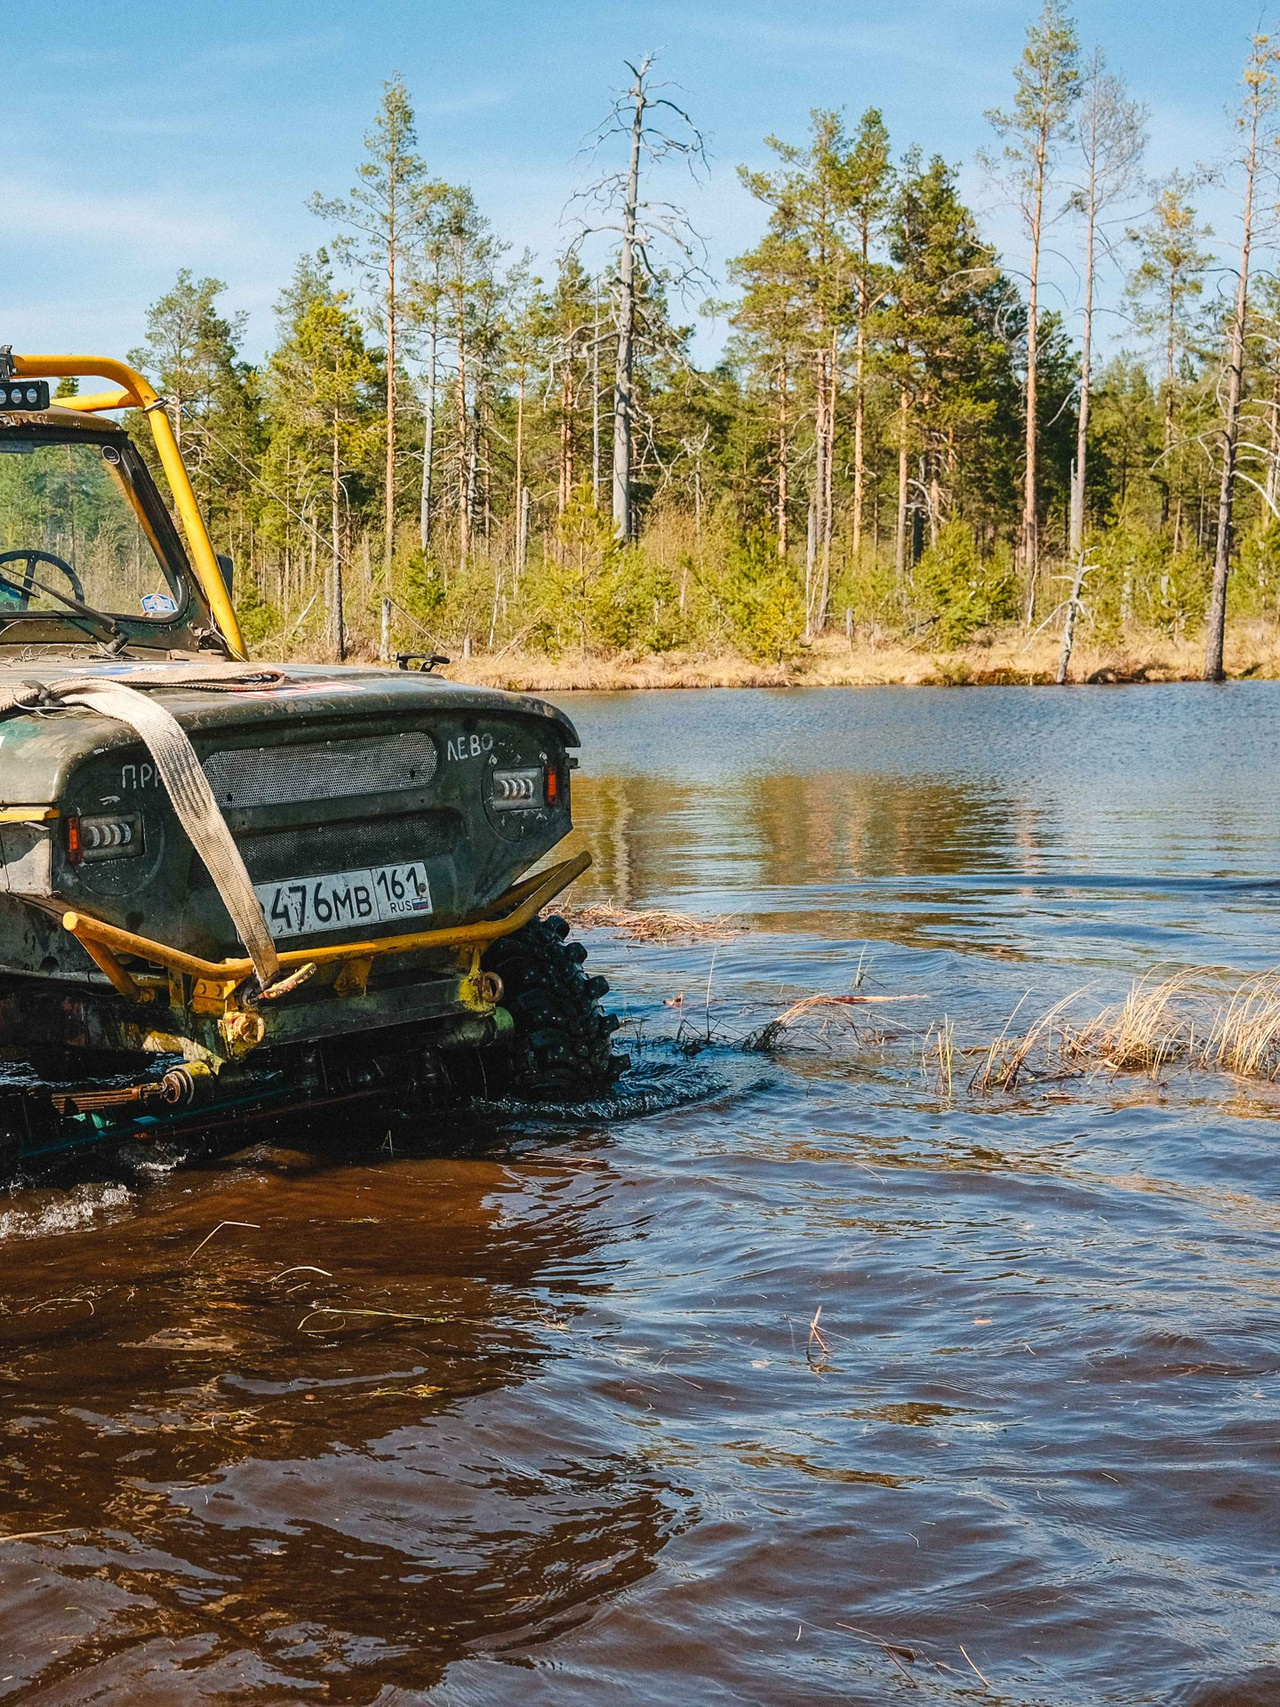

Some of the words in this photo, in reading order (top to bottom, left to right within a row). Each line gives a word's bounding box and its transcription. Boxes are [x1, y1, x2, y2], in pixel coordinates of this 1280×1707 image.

[446, 733, 493, 762] ЛЕВО
[260, 882, 372, 929] 476МВ
[377, 866, 420, 902] 161
[390, 900, 412, 913] RUS
